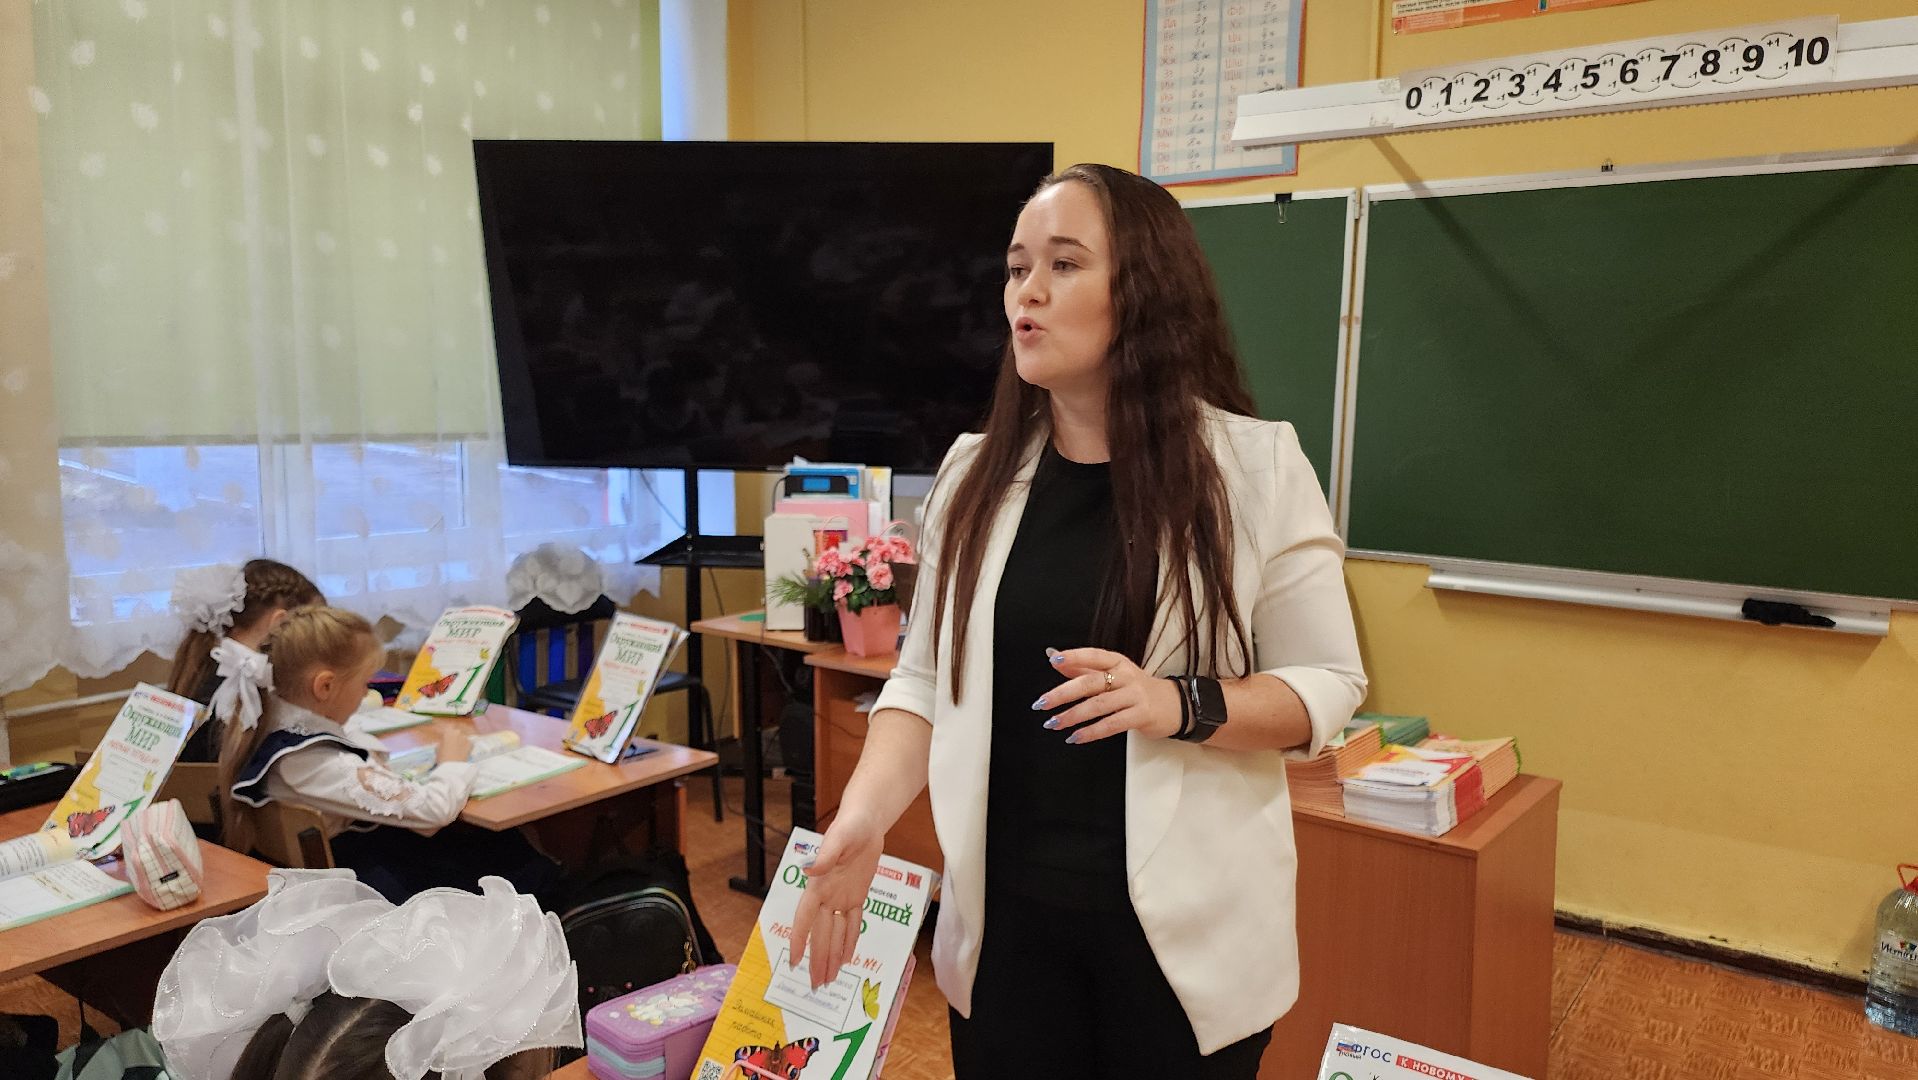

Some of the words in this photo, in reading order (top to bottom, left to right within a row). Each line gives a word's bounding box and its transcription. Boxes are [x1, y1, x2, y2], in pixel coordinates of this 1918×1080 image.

[1406, 87, 1422, 110] 0
[1440, 83, 1452, 106] 1
[1472, 78, 1490, 103] 2
[1508, 74, 1525, 98] 3
[1543, 69, 1562, 93] 4
[1581, 64, 1600, 89] 5
[1620, 59, 1639, 84] 6
[1660, 54, 1680, 81] 7
[1700, 50, 1721, 76] 8
[1742, 45, 1764, 72] 9
[1788, 36, 1830, 67] 10
[1423, 82, 1432, 90] +1
[1491, 73, 1500, 81] +1
[1527, 68, 1536, 76] +1
[1565, 63, 1575, 71] +1
[1603, 58, 1614, 66] +1
[1640, 54, 1651, 62] +1
[1682, 49, 1694, 58] +1
[1724, 43, 1736, 52] +1
[1767, 38, 1780, 47] +1
[1779, 62, 1789, 70] -1
[1352, 1043, 1392, 1062] ФГОС
